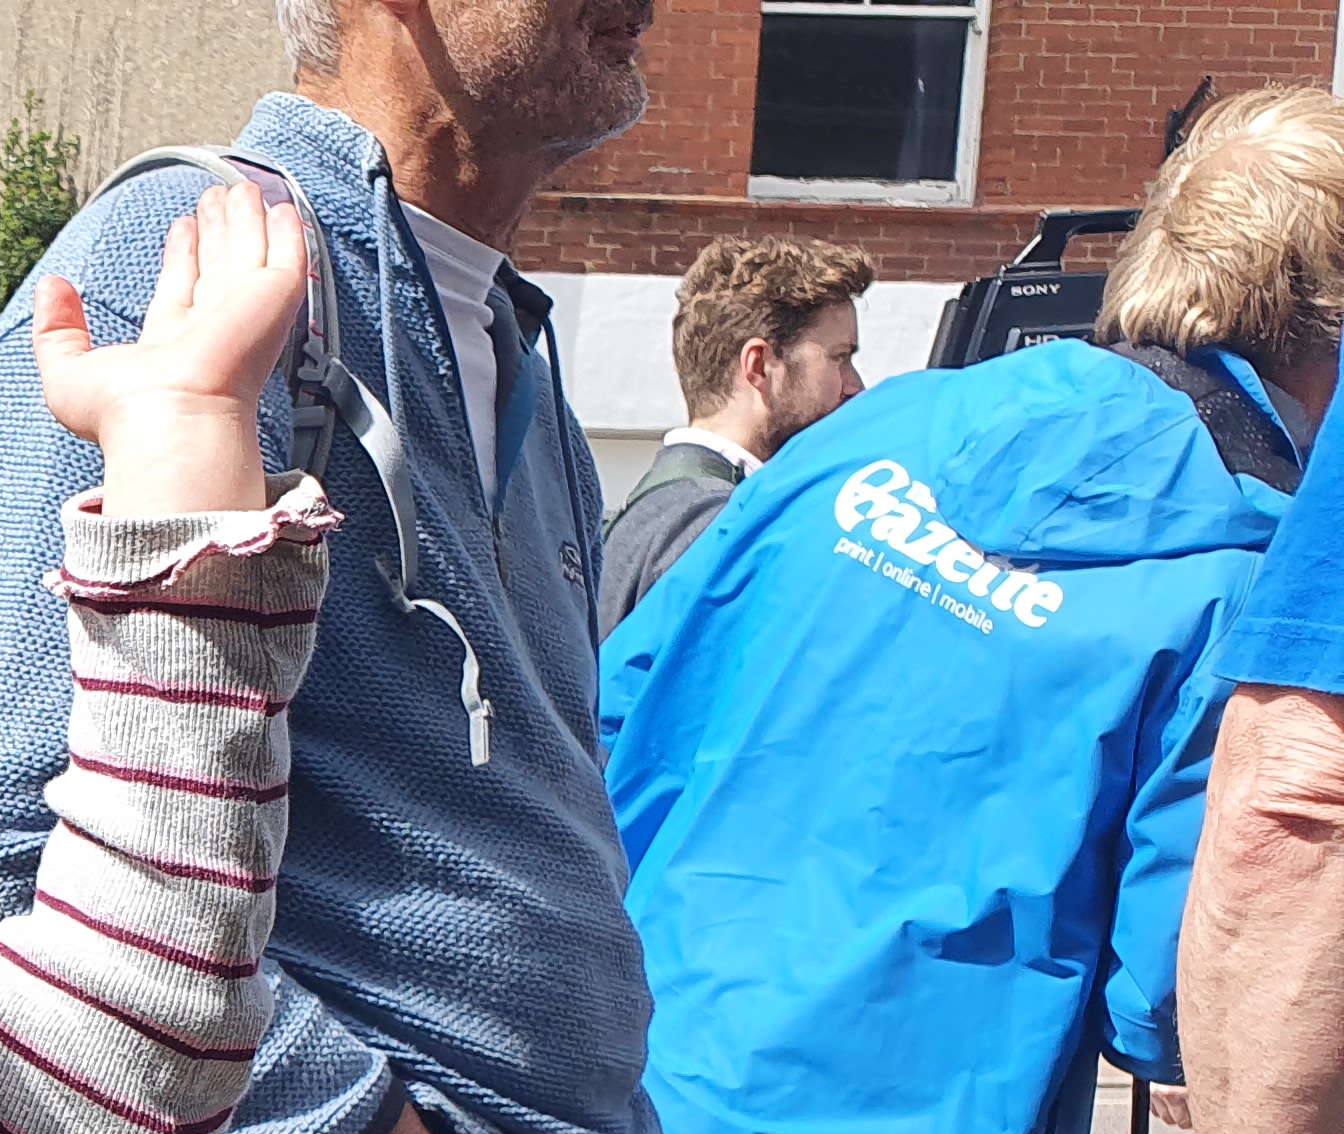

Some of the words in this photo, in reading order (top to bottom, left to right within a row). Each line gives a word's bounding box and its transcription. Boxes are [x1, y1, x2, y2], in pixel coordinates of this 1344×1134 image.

[1011, 283, 1061, 297] SONY
[833, 536, 876, 567] print
[882, 561, 932, 598] online
[939, 593, 994, 634] mobile
[834, 459, 1063, 628] Gazette
